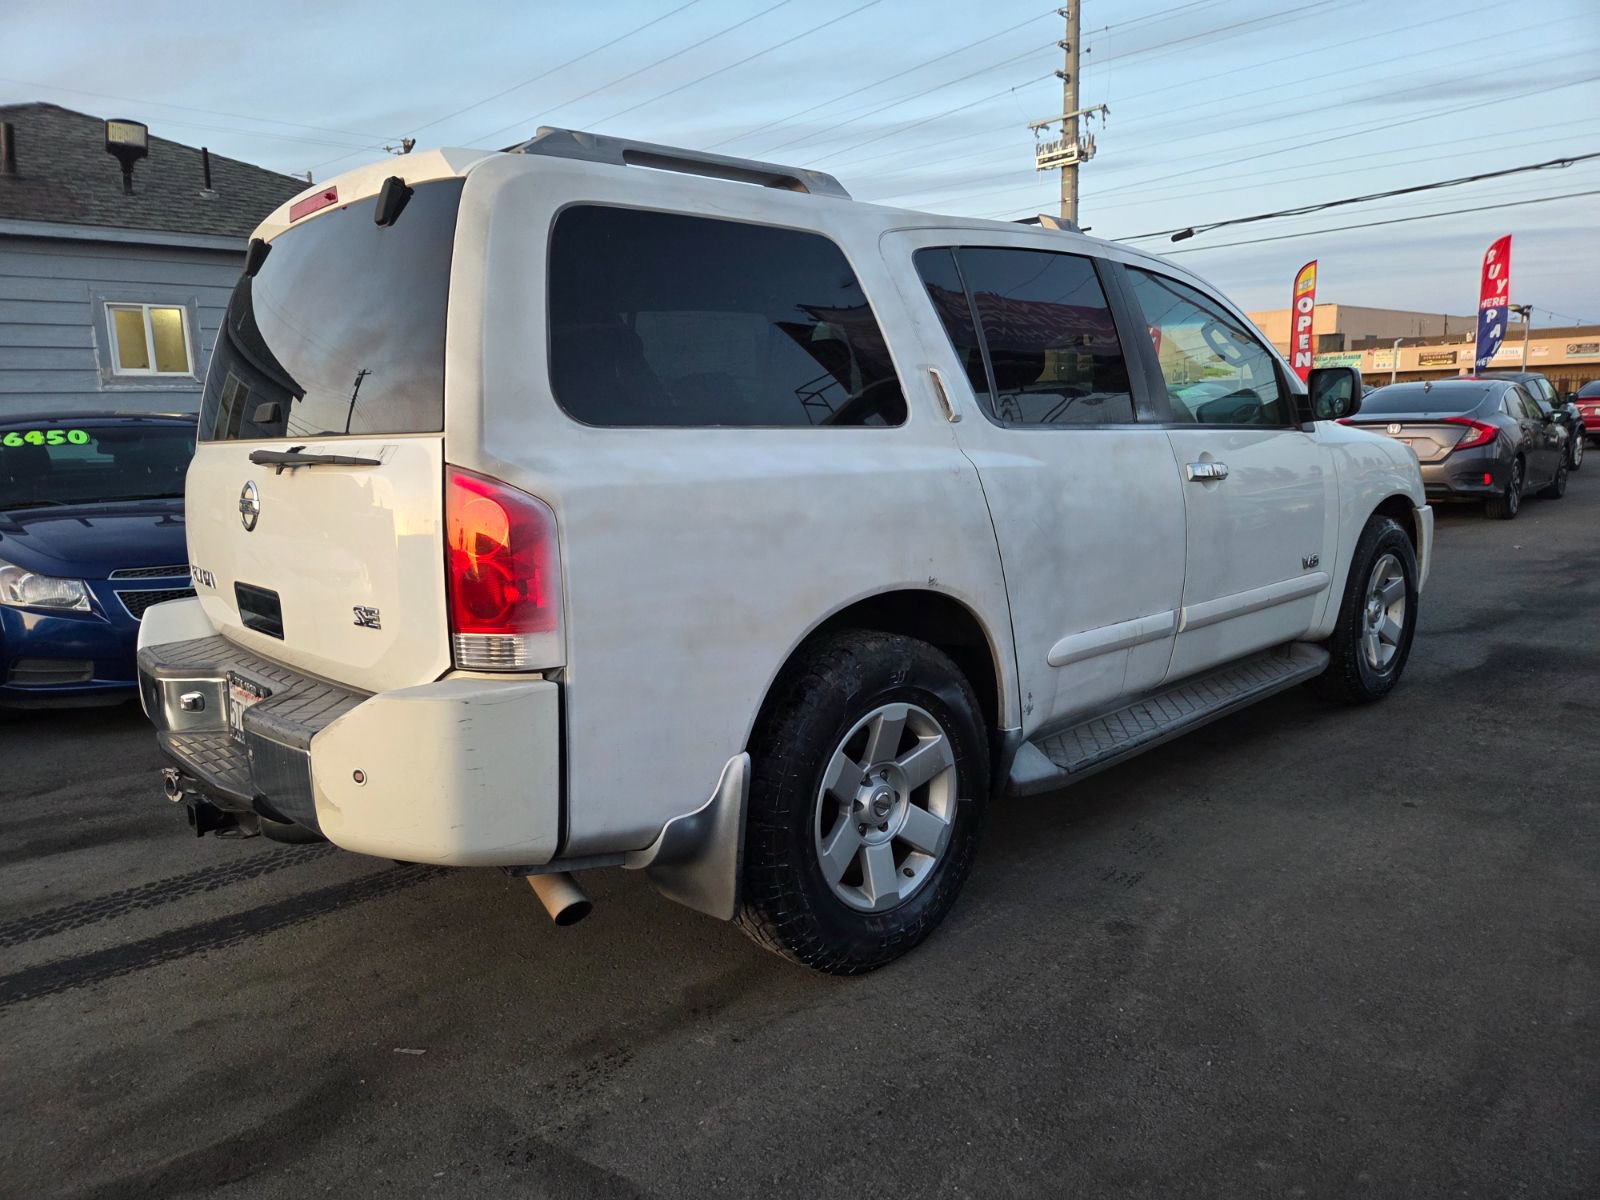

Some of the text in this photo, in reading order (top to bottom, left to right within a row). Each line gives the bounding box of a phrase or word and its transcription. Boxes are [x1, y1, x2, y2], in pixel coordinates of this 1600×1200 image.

[1486, 249, 1508, 295] BUY
[1480, 296, 1507, 309] HERE
[1295, 296, 1314, 368] OPEN
[3, 429, 90, 447] 6450
[353, 605, 381, 630] SE
